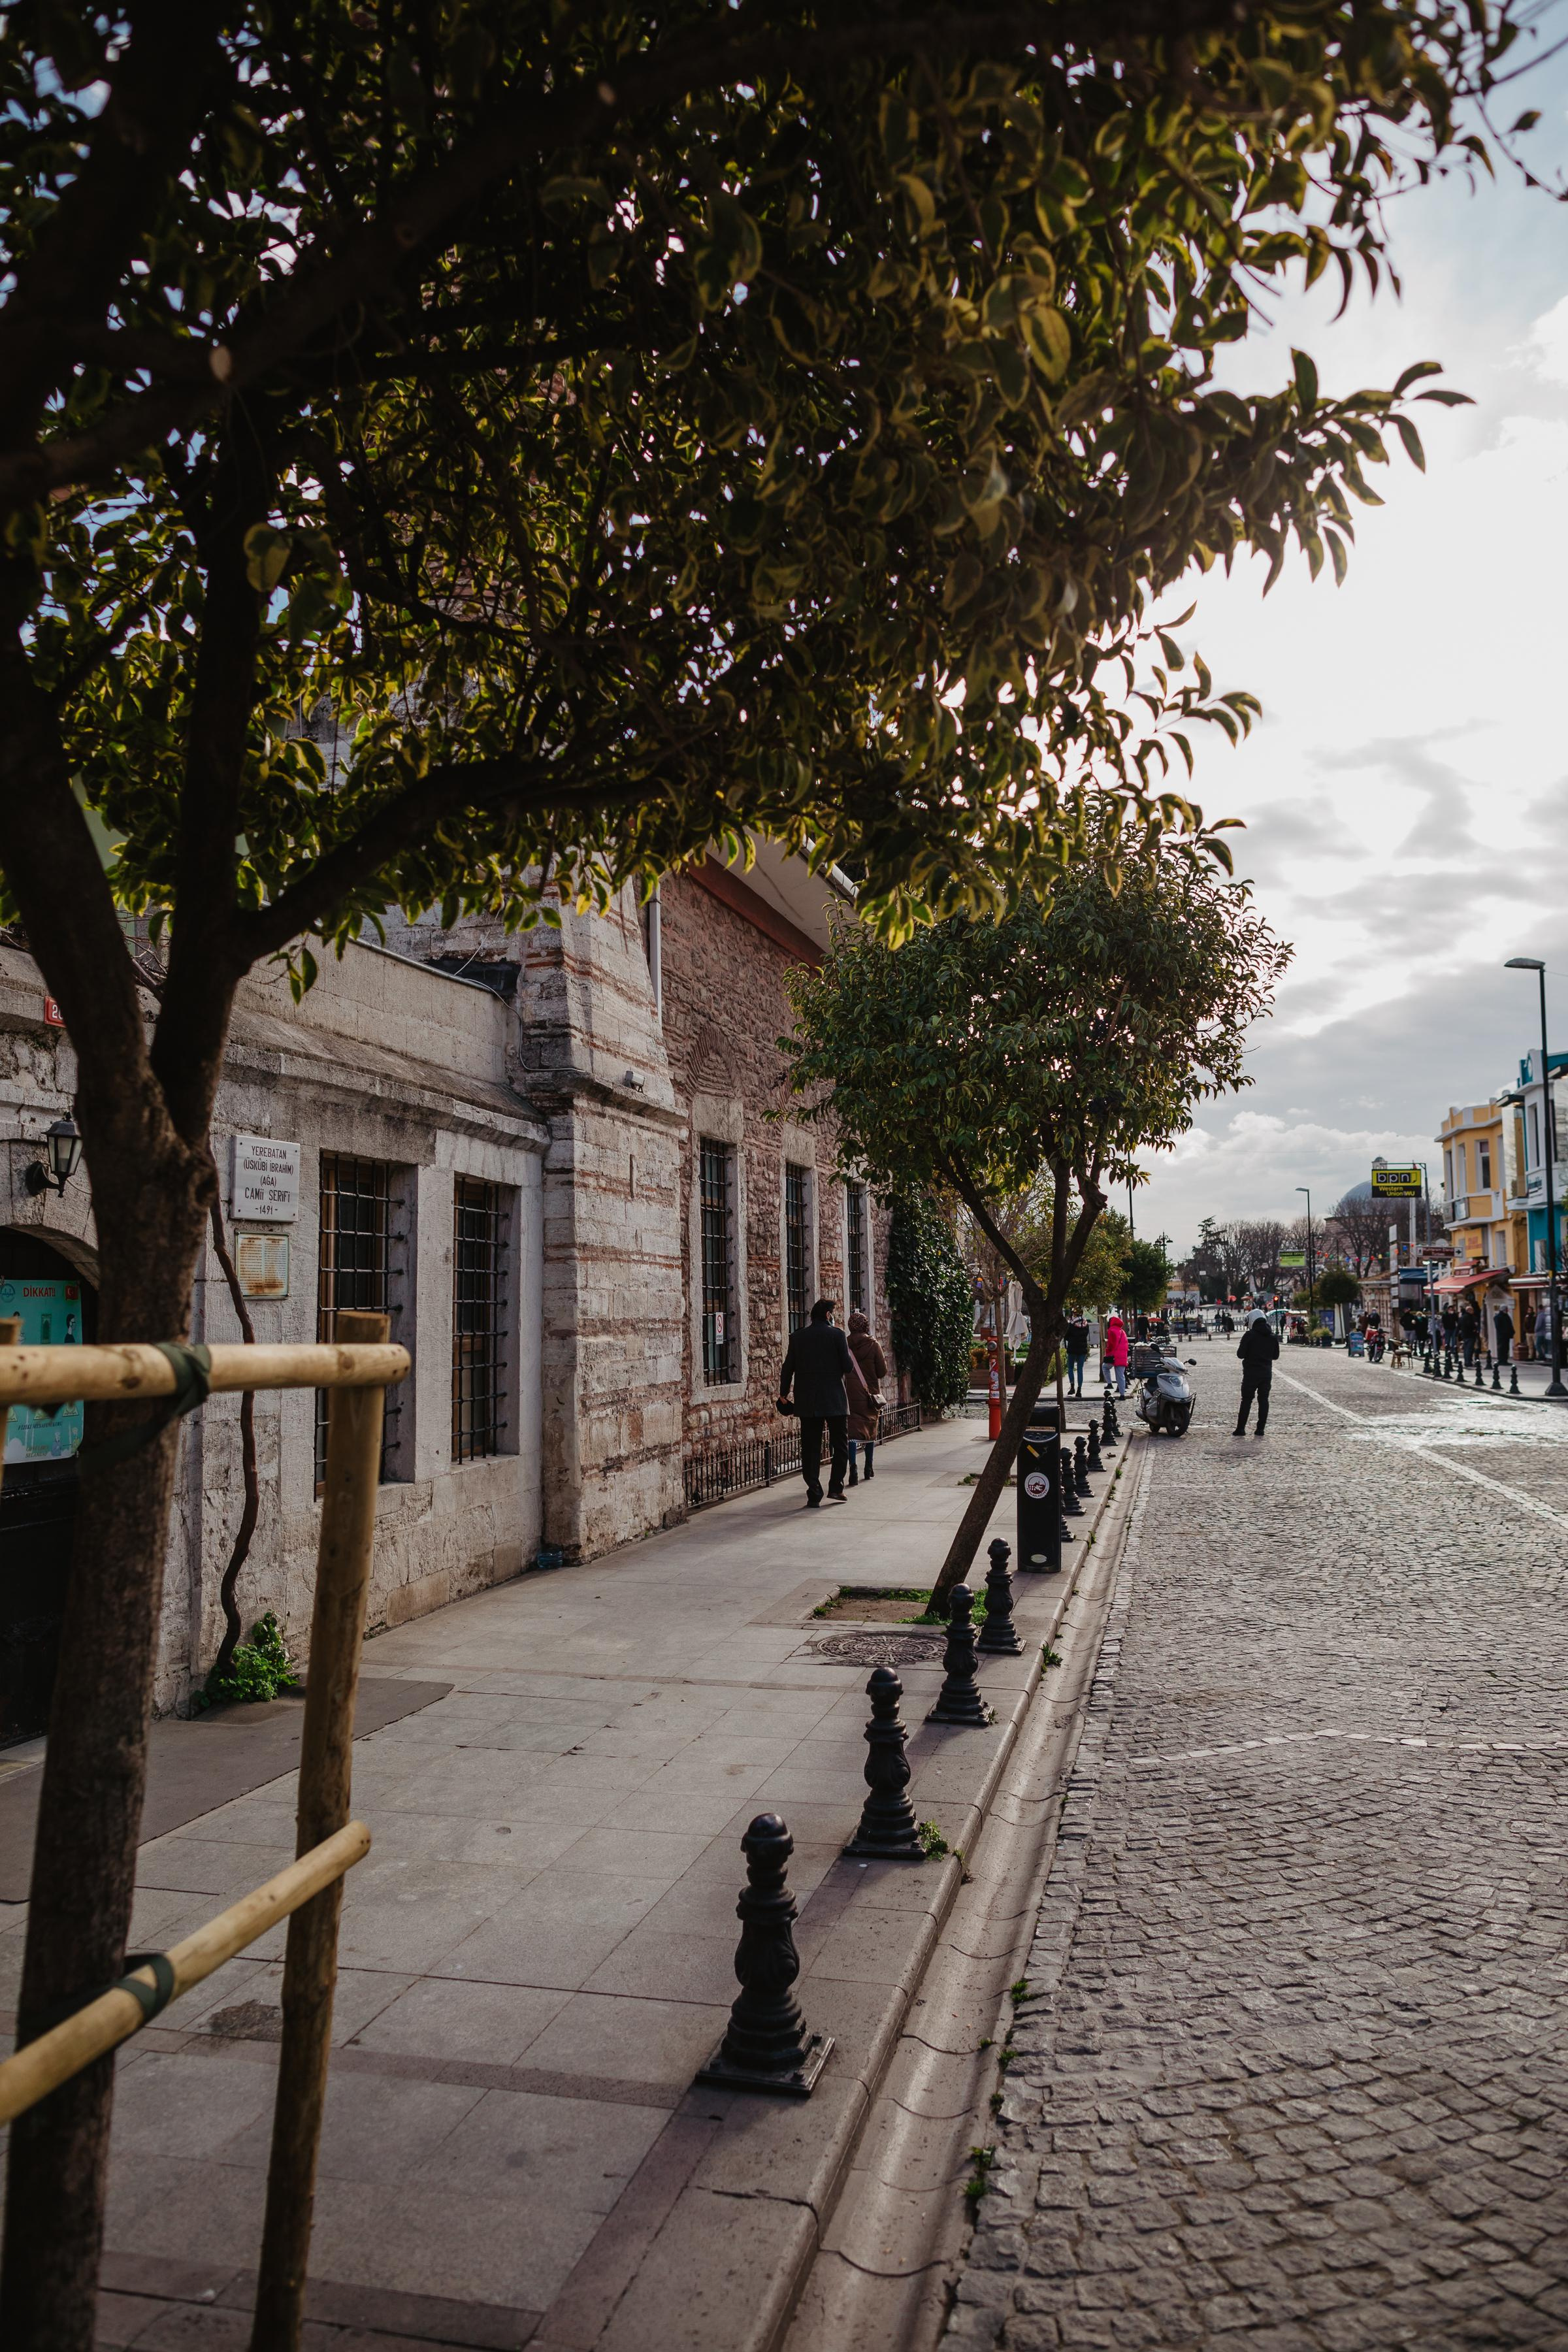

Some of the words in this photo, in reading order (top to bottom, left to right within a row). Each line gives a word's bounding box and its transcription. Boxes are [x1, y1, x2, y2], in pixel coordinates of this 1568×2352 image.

[251, 1145, 287, 1160] YEREBATAN
[269, 1160, 294, 1176] İBRAHİM)
[260, 1174, 277, 1188] (AĞA)
[1377, 1173, 1409, 1183] bpn
[269, 1190, 291, 1203] ŞERİFİ
[23, 1285, 56, 1298] DİKKAT!!
